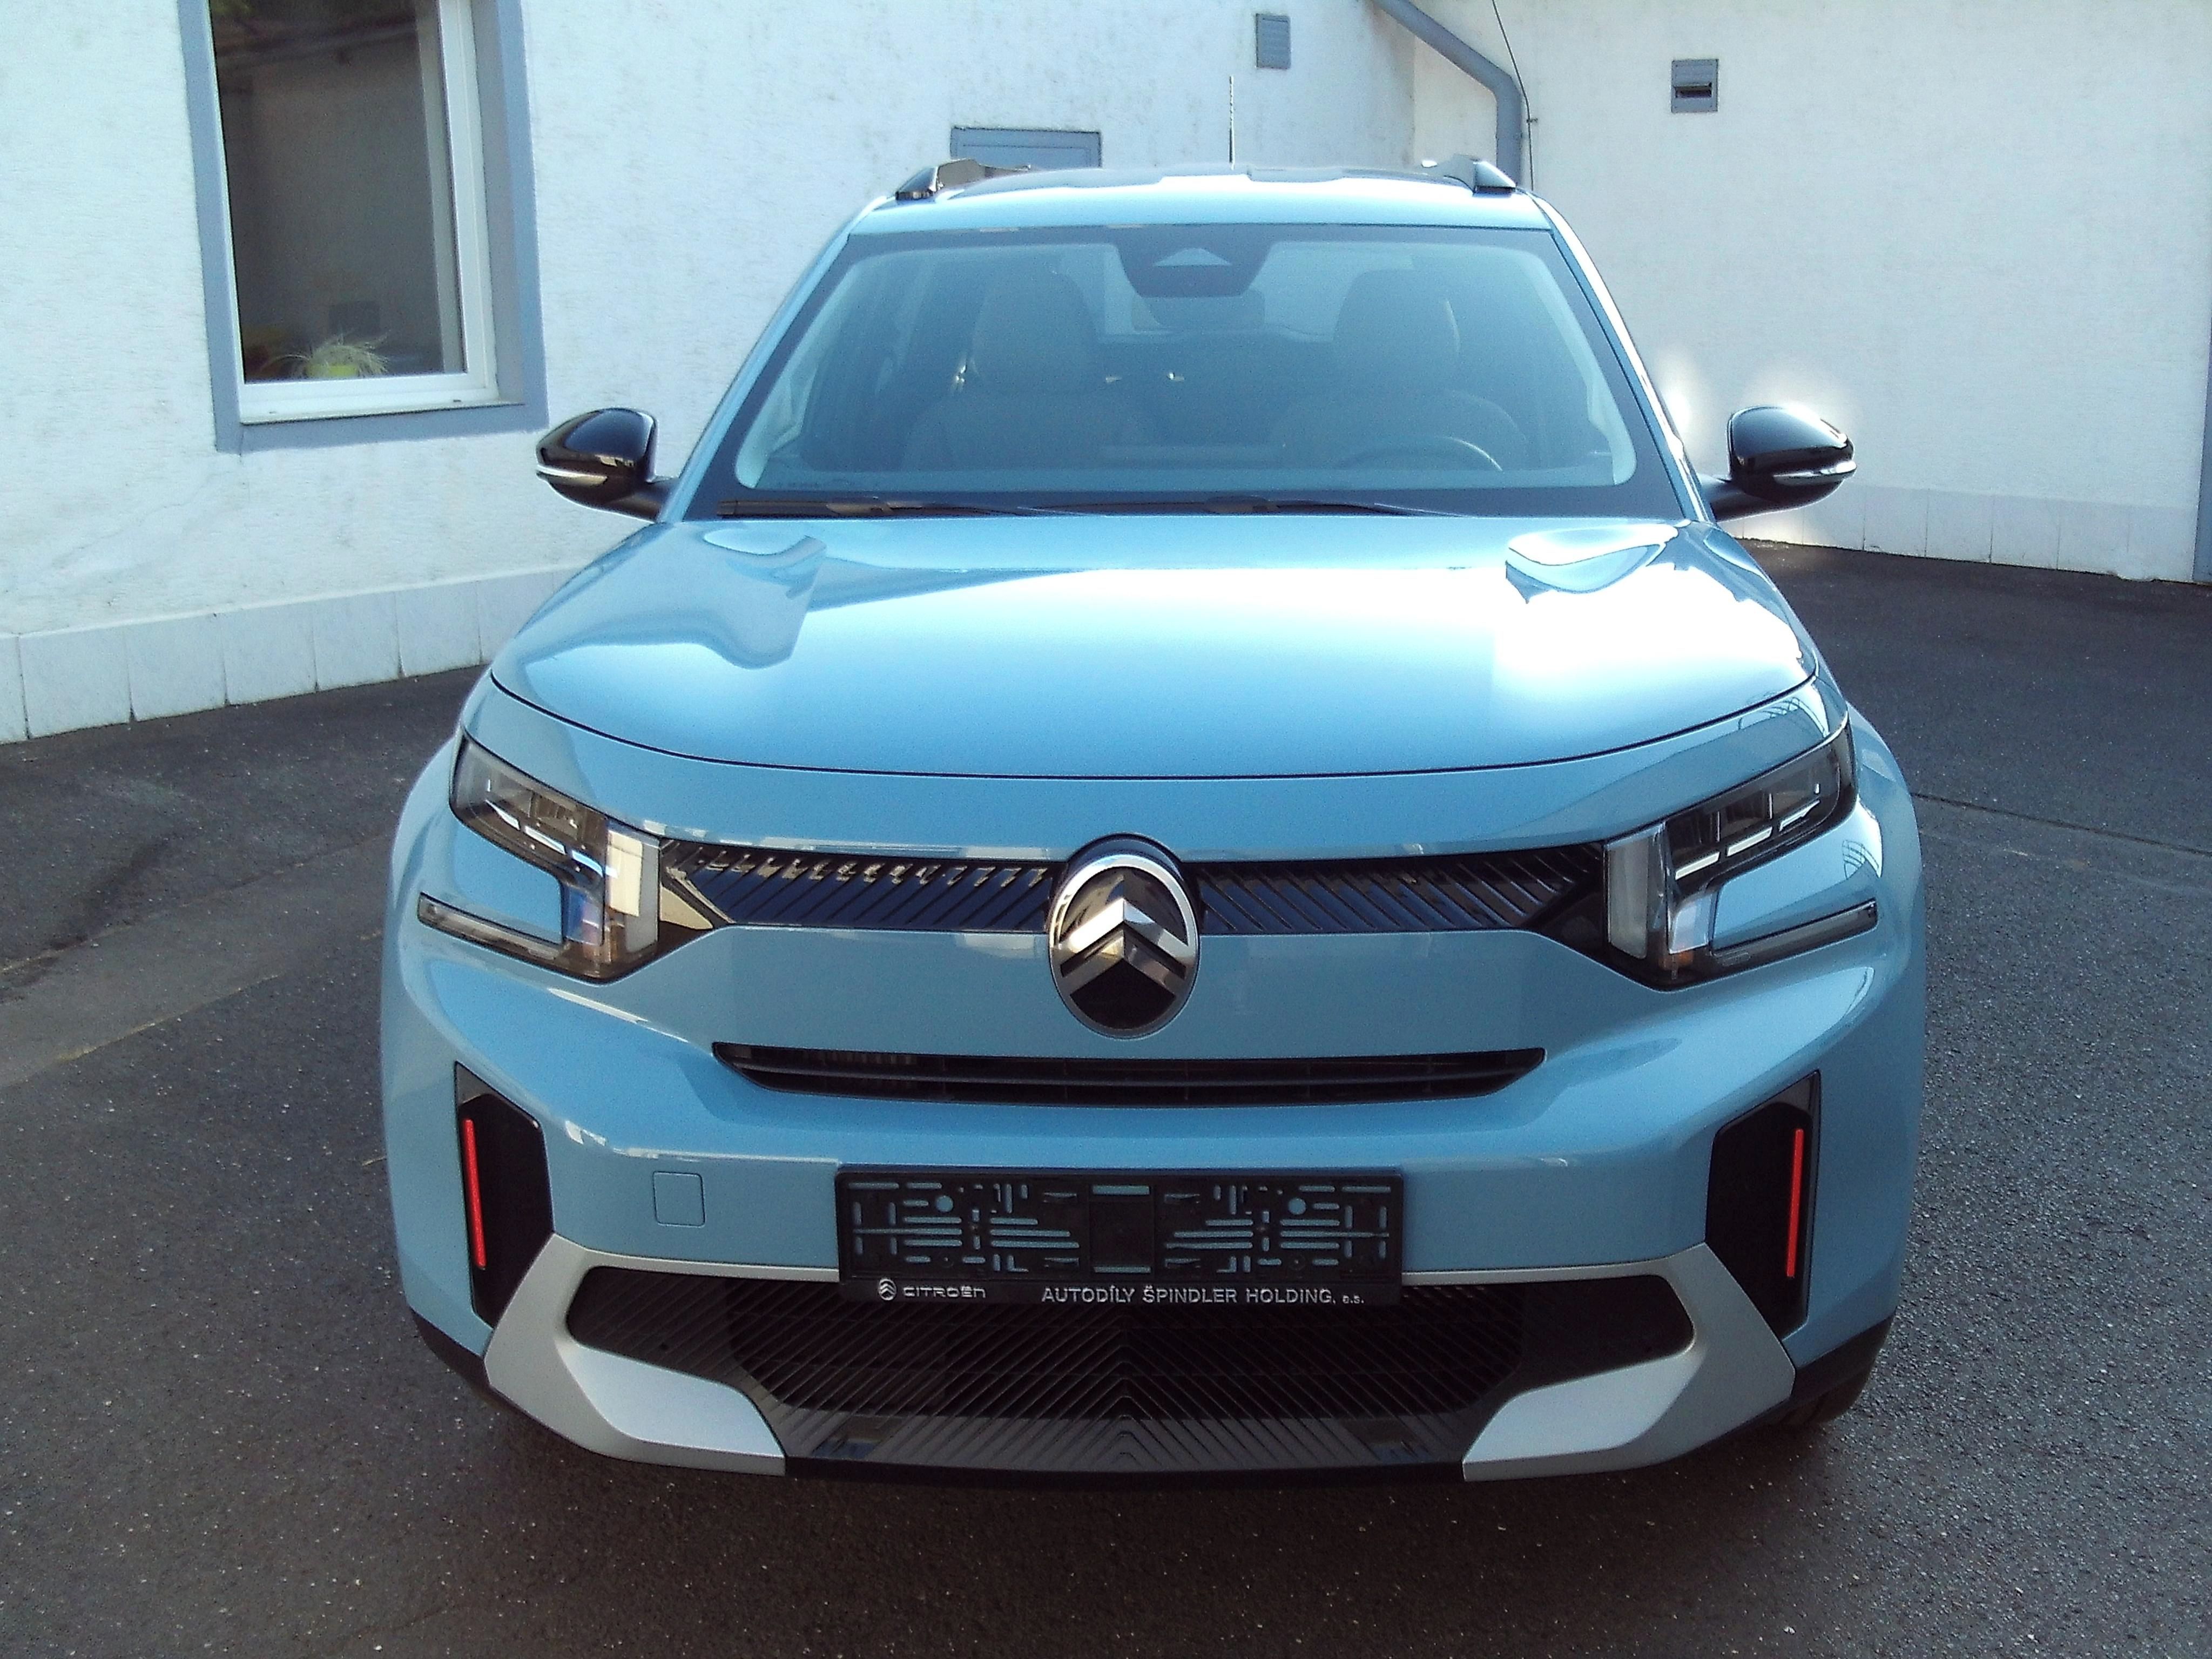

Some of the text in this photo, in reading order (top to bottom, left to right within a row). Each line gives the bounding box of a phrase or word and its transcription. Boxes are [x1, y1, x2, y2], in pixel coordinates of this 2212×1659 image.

[1042, 1285, 1135, 1303] AUTODÍLY
[1142, 1285, 1237, 1303] ŠPINDLER
[1343, 1294, 1364, 1304] a.s.
